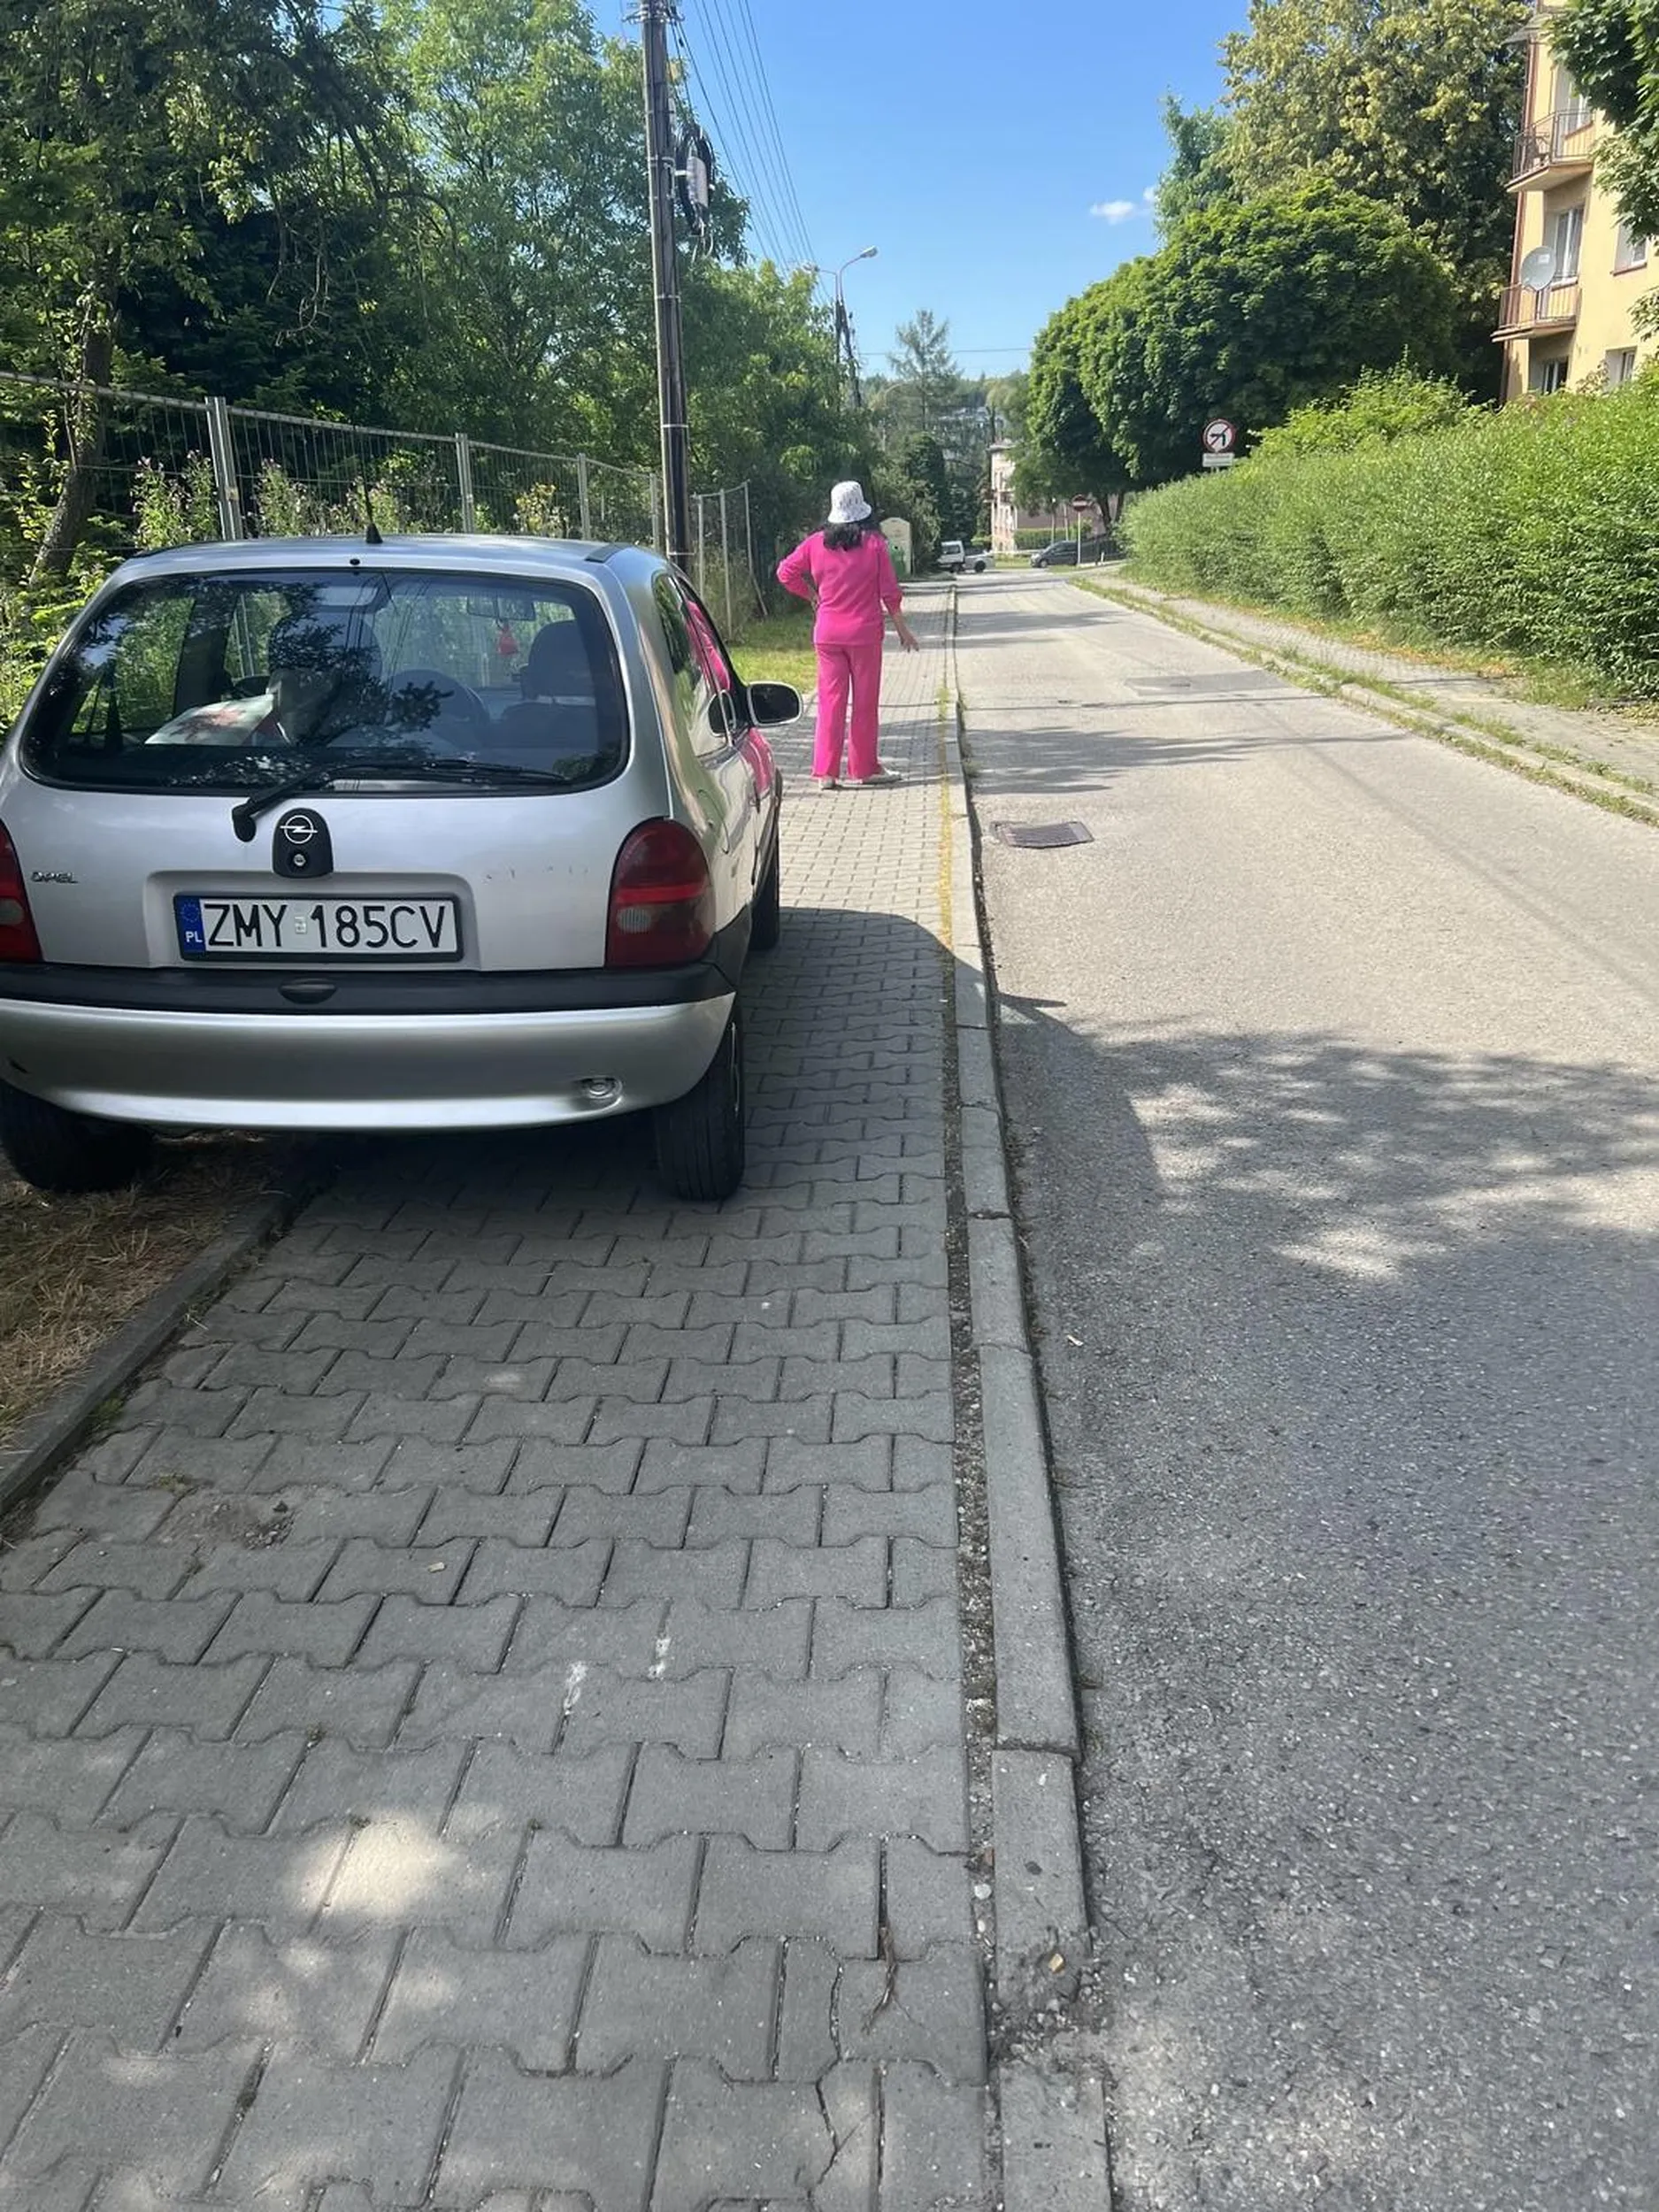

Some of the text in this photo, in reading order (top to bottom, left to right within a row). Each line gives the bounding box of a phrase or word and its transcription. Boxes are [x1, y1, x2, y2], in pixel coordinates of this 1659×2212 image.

[185, 931, 204, 943] PL
[204, 904, 445, 949] ZMY 185CV
